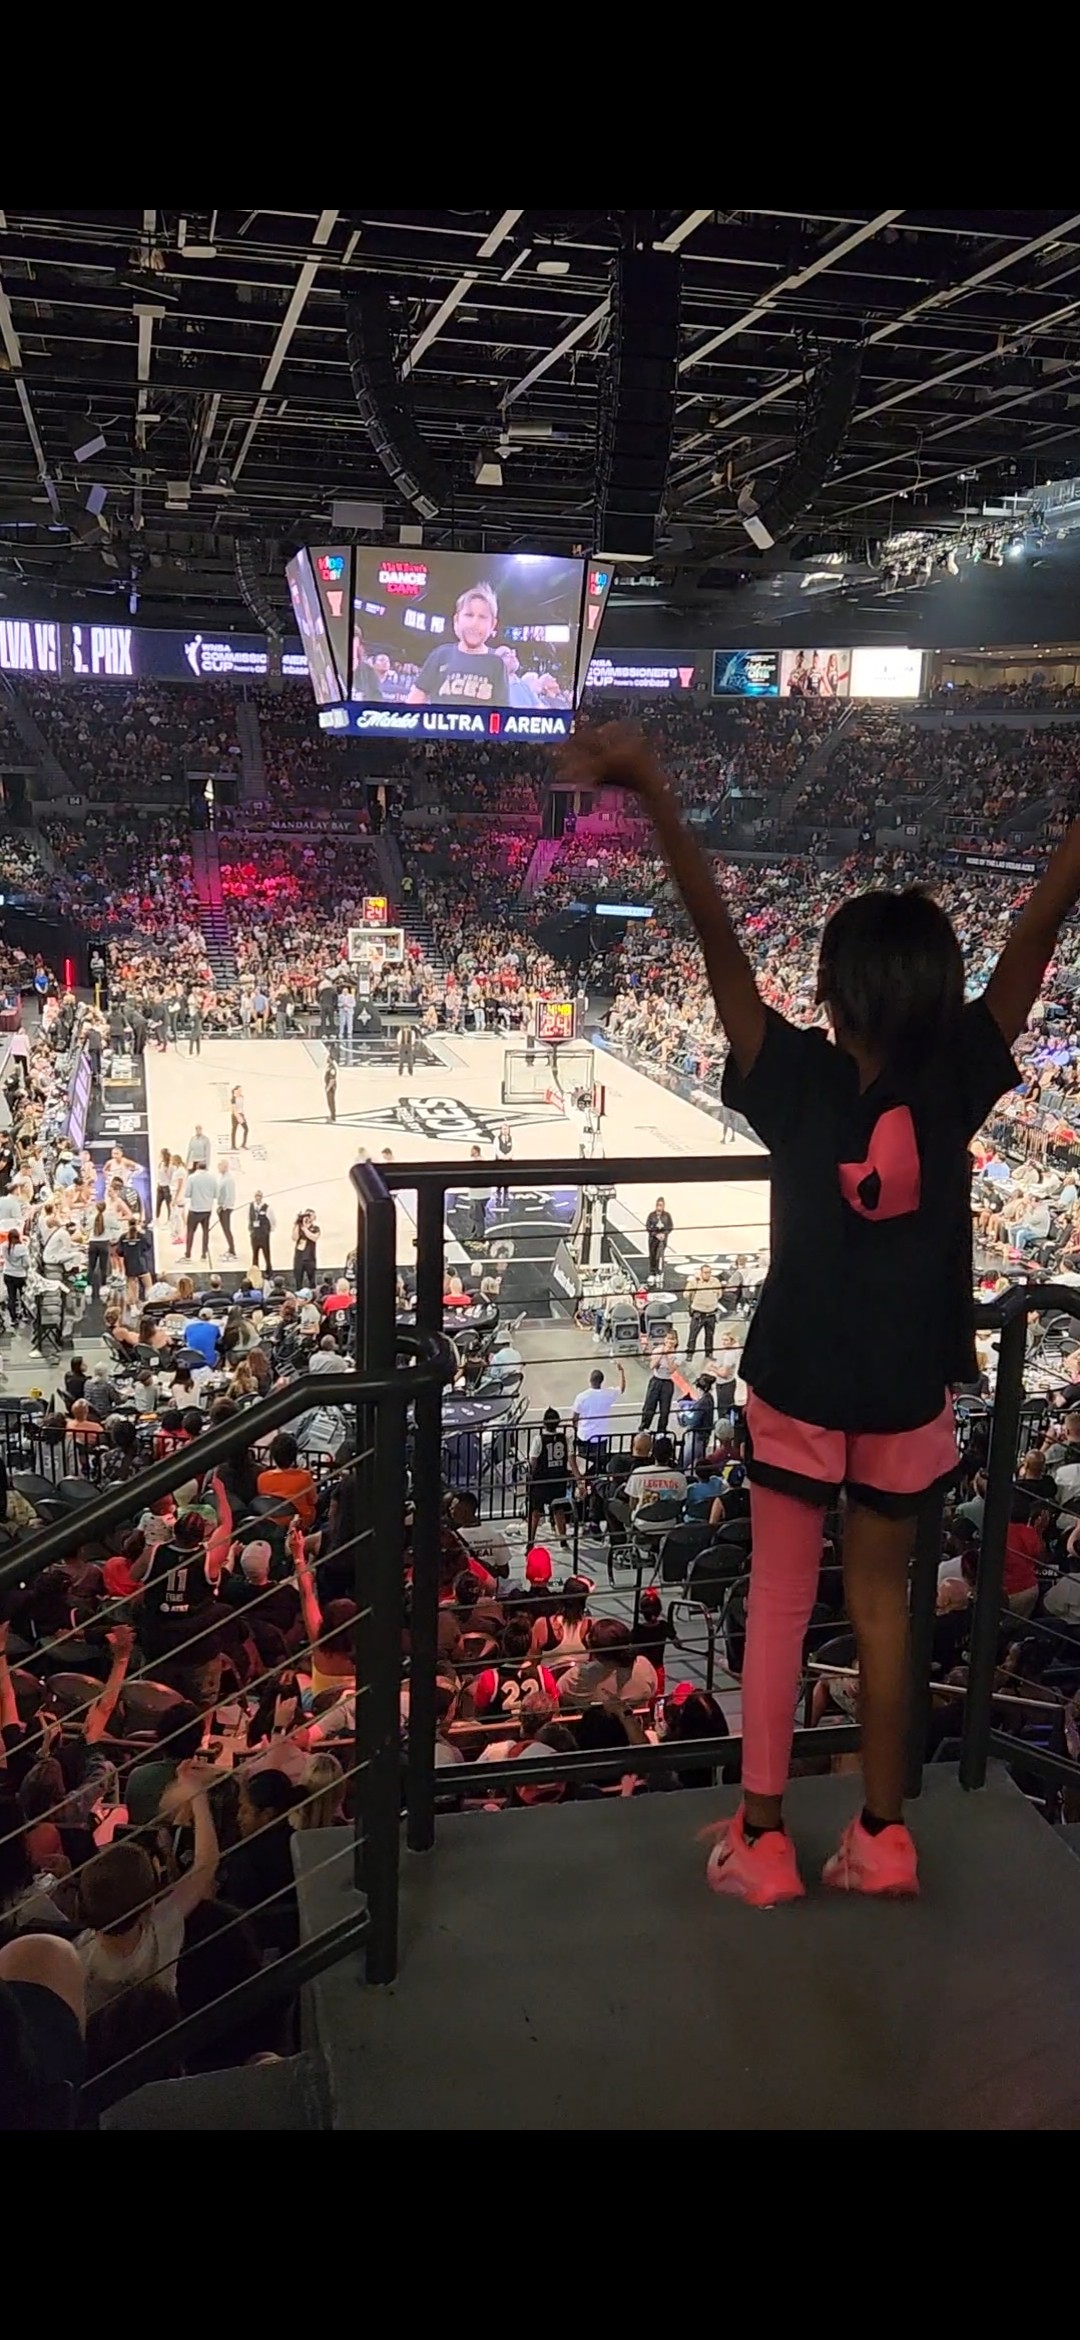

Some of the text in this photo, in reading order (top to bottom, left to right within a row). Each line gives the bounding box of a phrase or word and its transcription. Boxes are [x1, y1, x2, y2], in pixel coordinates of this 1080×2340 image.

[379, 571, 427, 586] DANCE
[91, 627, 133, 675] PHX
[201, 643, 232, 653] WNBA
[201, 660, 234, 672] CUP
[439, 679, 493, 700] ACES
[423, 712, 485, 732] ULTRA
[504, 715, 566, 734] ARENA
[271, 821, 351, 830] MANDALAY BAY
[366, 905, 383, 919] 24
[546, 1441, 565, 1461] 18
[642, 1479, 680, 1490] LEGENDS
[166, 1568, 188, 1592] 11
